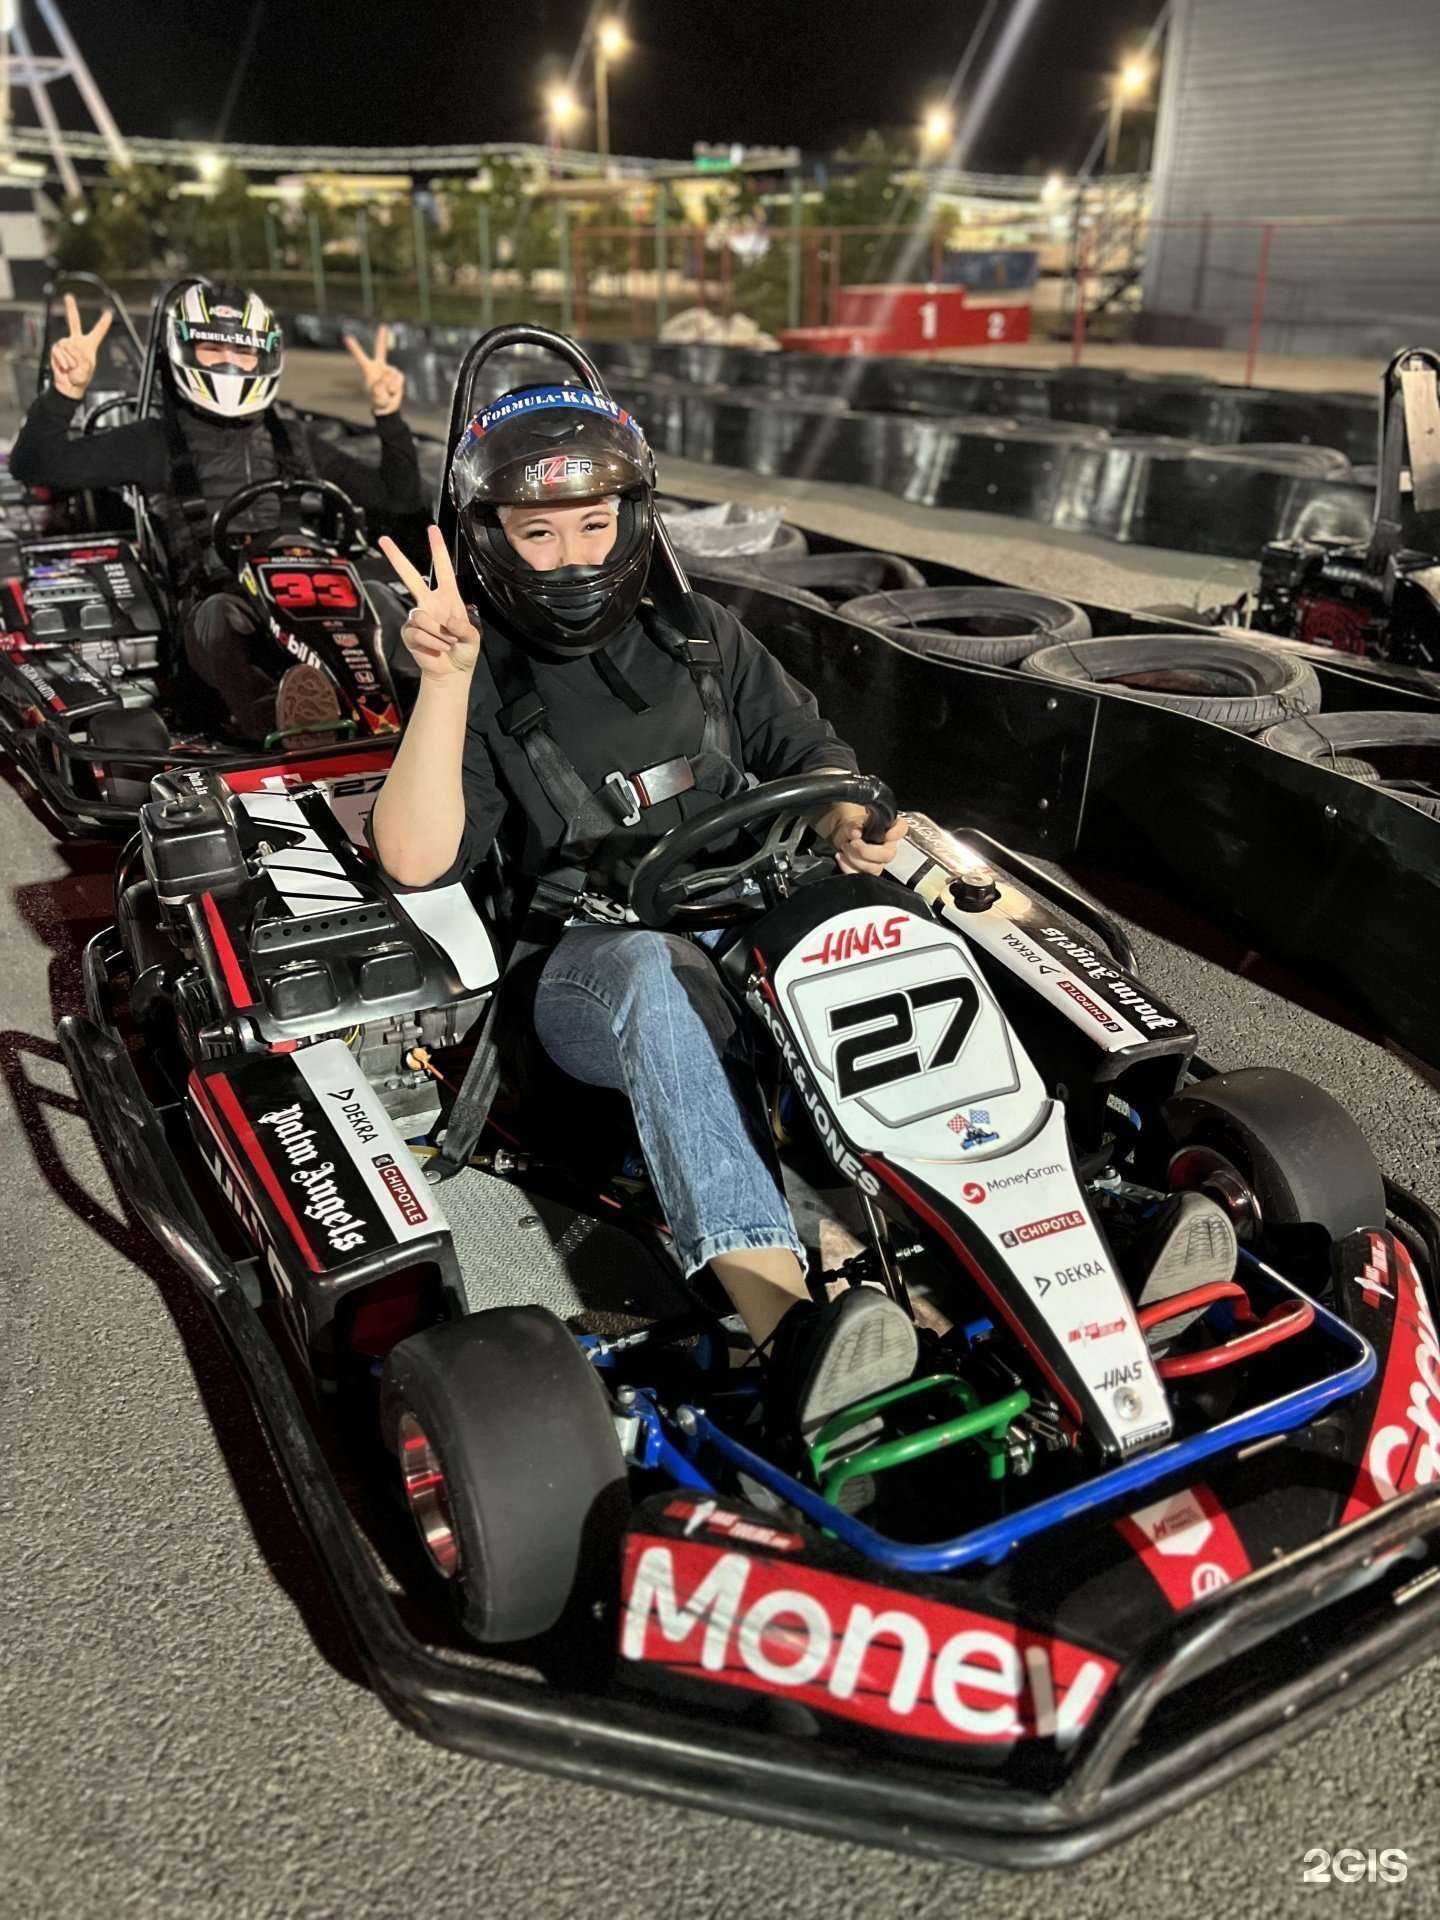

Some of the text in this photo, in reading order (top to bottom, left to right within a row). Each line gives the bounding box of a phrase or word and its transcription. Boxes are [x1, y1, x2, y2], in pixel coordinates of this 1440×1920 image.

[918, 302, 938, 340] 1
[987, 311, 1006, 340] 2
[524, 455, 594, 485] HIZER
[270, 572, 358, 609] 33
[802, 916, 910, 965] HAAS
[1001, 933, 1042, 964] DEKRA
[1058, 981, 1110, 1022] CHIPOTLE
[1108, 979, 1179, 1031] Palm
[827, 975, 982, 1103] 27
[341, 1102, 380, 1145] DEKRA
[257, 1103, 368, 1252] Palm Angels
[383, 1166, 426, 1225] CHIPOTLE
[986, 1162, 1066, 1193] MoneyGram
[1018, 1211, 1084, 1242] CHIPOTLE
[1055, 1259, 1106, 1288] DEKRA
[1093, 1361, 1143, 1392] HAAS
